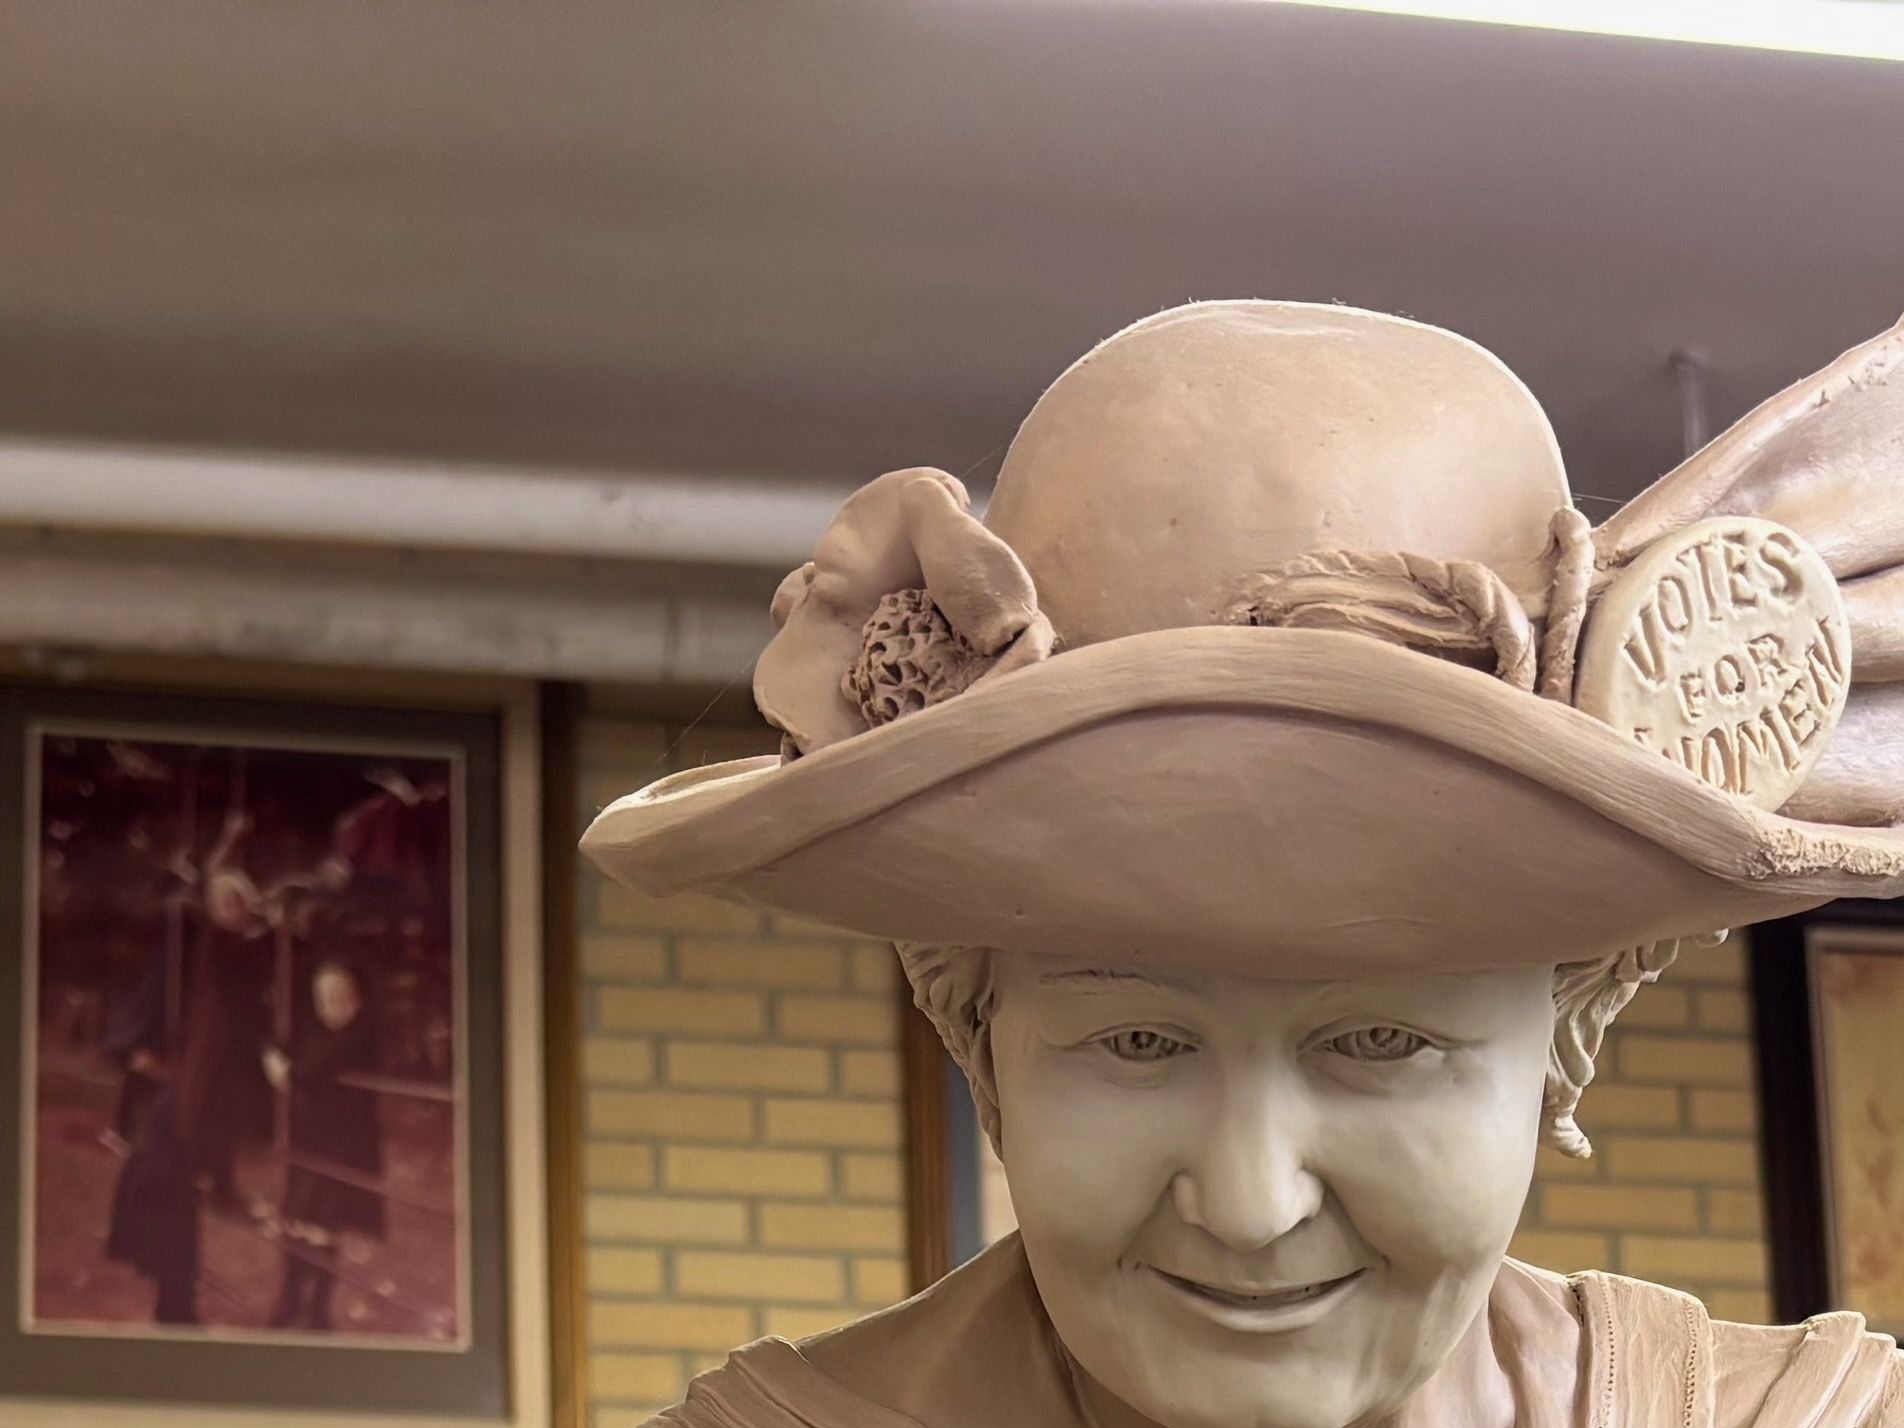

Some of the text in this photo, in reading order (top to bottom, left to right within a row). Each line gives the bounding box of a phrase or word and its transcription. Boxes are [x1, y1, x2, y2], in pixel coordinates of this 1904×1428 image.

[1623, 532, 1803, 683] VOTES
[1679, 632, 1787, 718] FOR
[1633, 614, 1843, 795] OMEN
